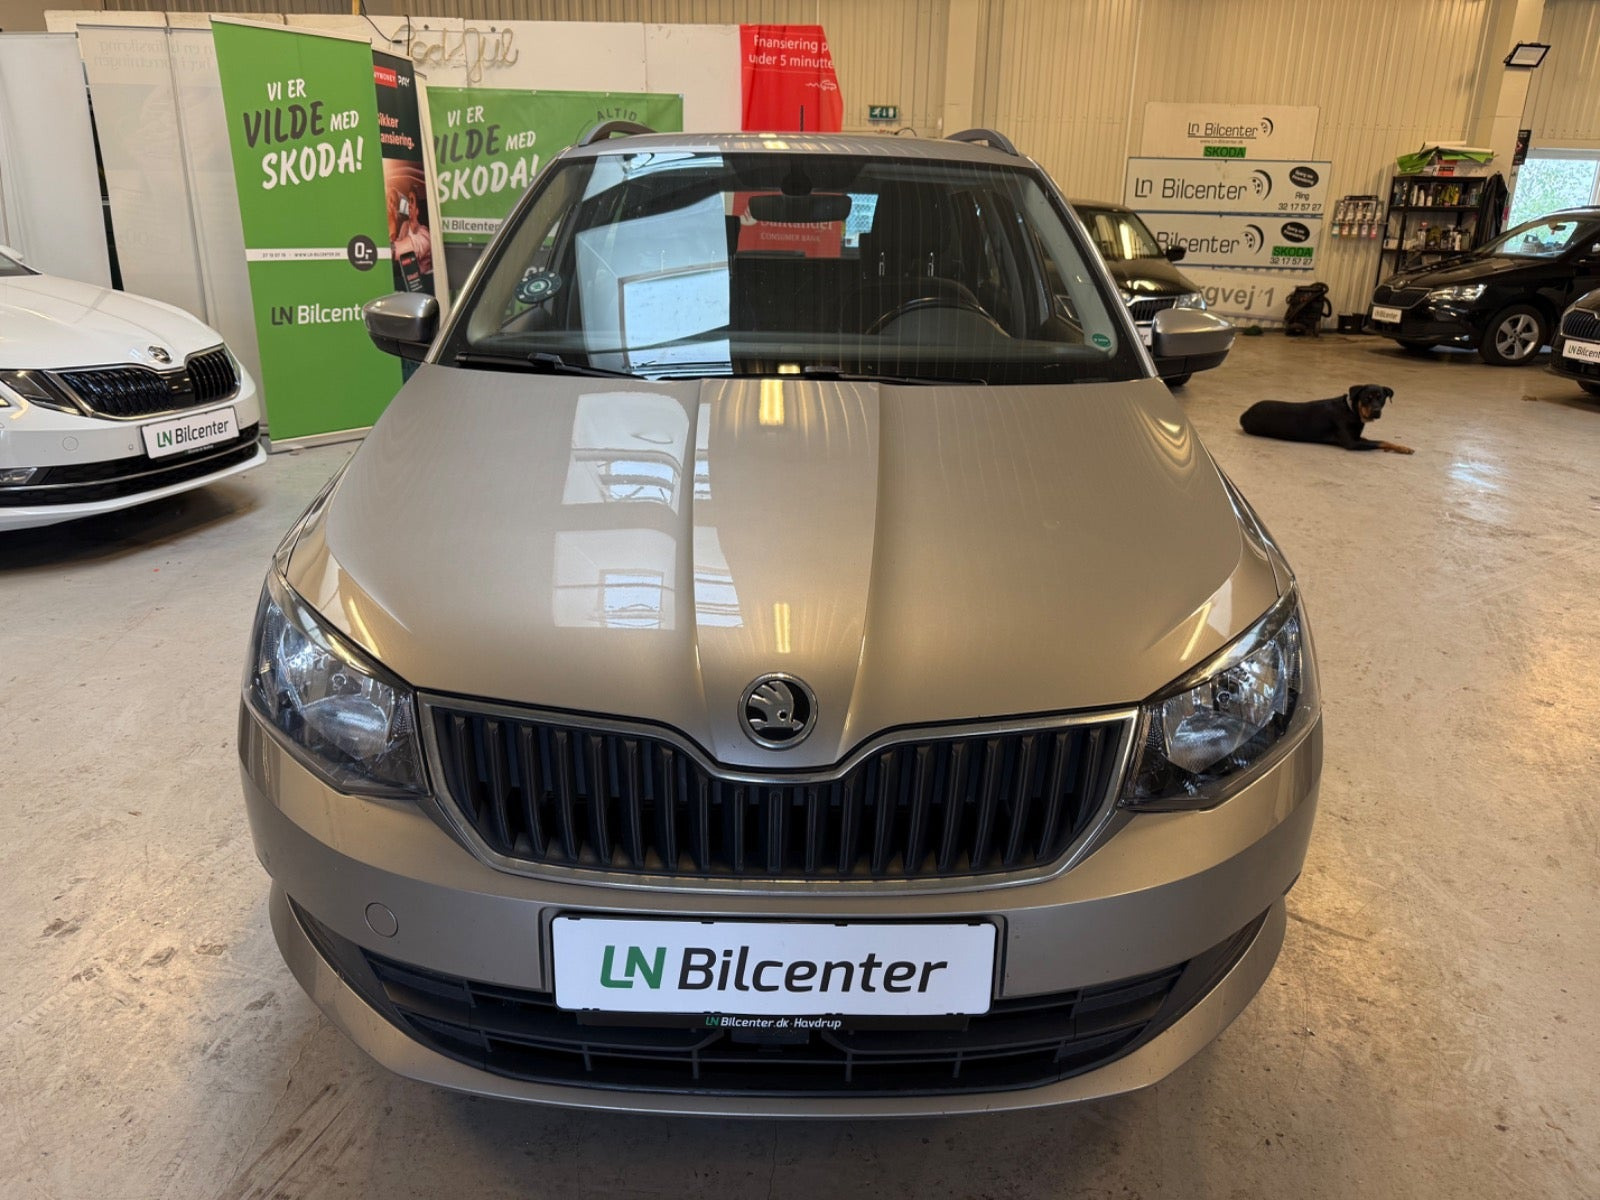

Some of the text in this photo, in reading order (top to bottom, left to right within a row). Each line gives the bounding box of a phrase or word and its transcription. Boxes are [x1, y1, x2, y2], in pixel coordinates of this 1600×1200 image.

[753, 34, 819, 54] Fnansiering
[780, 54, 787, 67] 5
[267, 78, 307, 101] VI ER
[243, 101, 359, 148] VILDE MED
[447, 105, 485, 127] VI ER
[597, 107, 637, 121] ALTID
[1204, 122, 1258, 137] Bilcenter
[505, 130, 536, 151] MED
[261, 135, 364, 190] SKODA!
[1205, 147, 1245, 157] SKODA
[437, 154, 540, 203] SKODA!
[1162, 177, 1247, 200] Bilcenter
[1294, 191, 1310, 201] Ring
[1278, 203, 1321, 211] 32 17 57 27
[1269, 257, 1279, 265] 32
[1282, 257, 1290, 265] 17
[1292, 257, 1301, 265] 57
[1272, 246, 1313, 257] SKODA
[1200, 285, 1275, 310] gvej 1
[271, 303, 365, 325] LN Bilcent
[156, 420, 229, 448] LN Bilcenter
[600, 945, 948, 993] LN Bilcenter
[705, 1016, 719, 1026] LN
[793, 1018, 842, 1030] Havdrup
